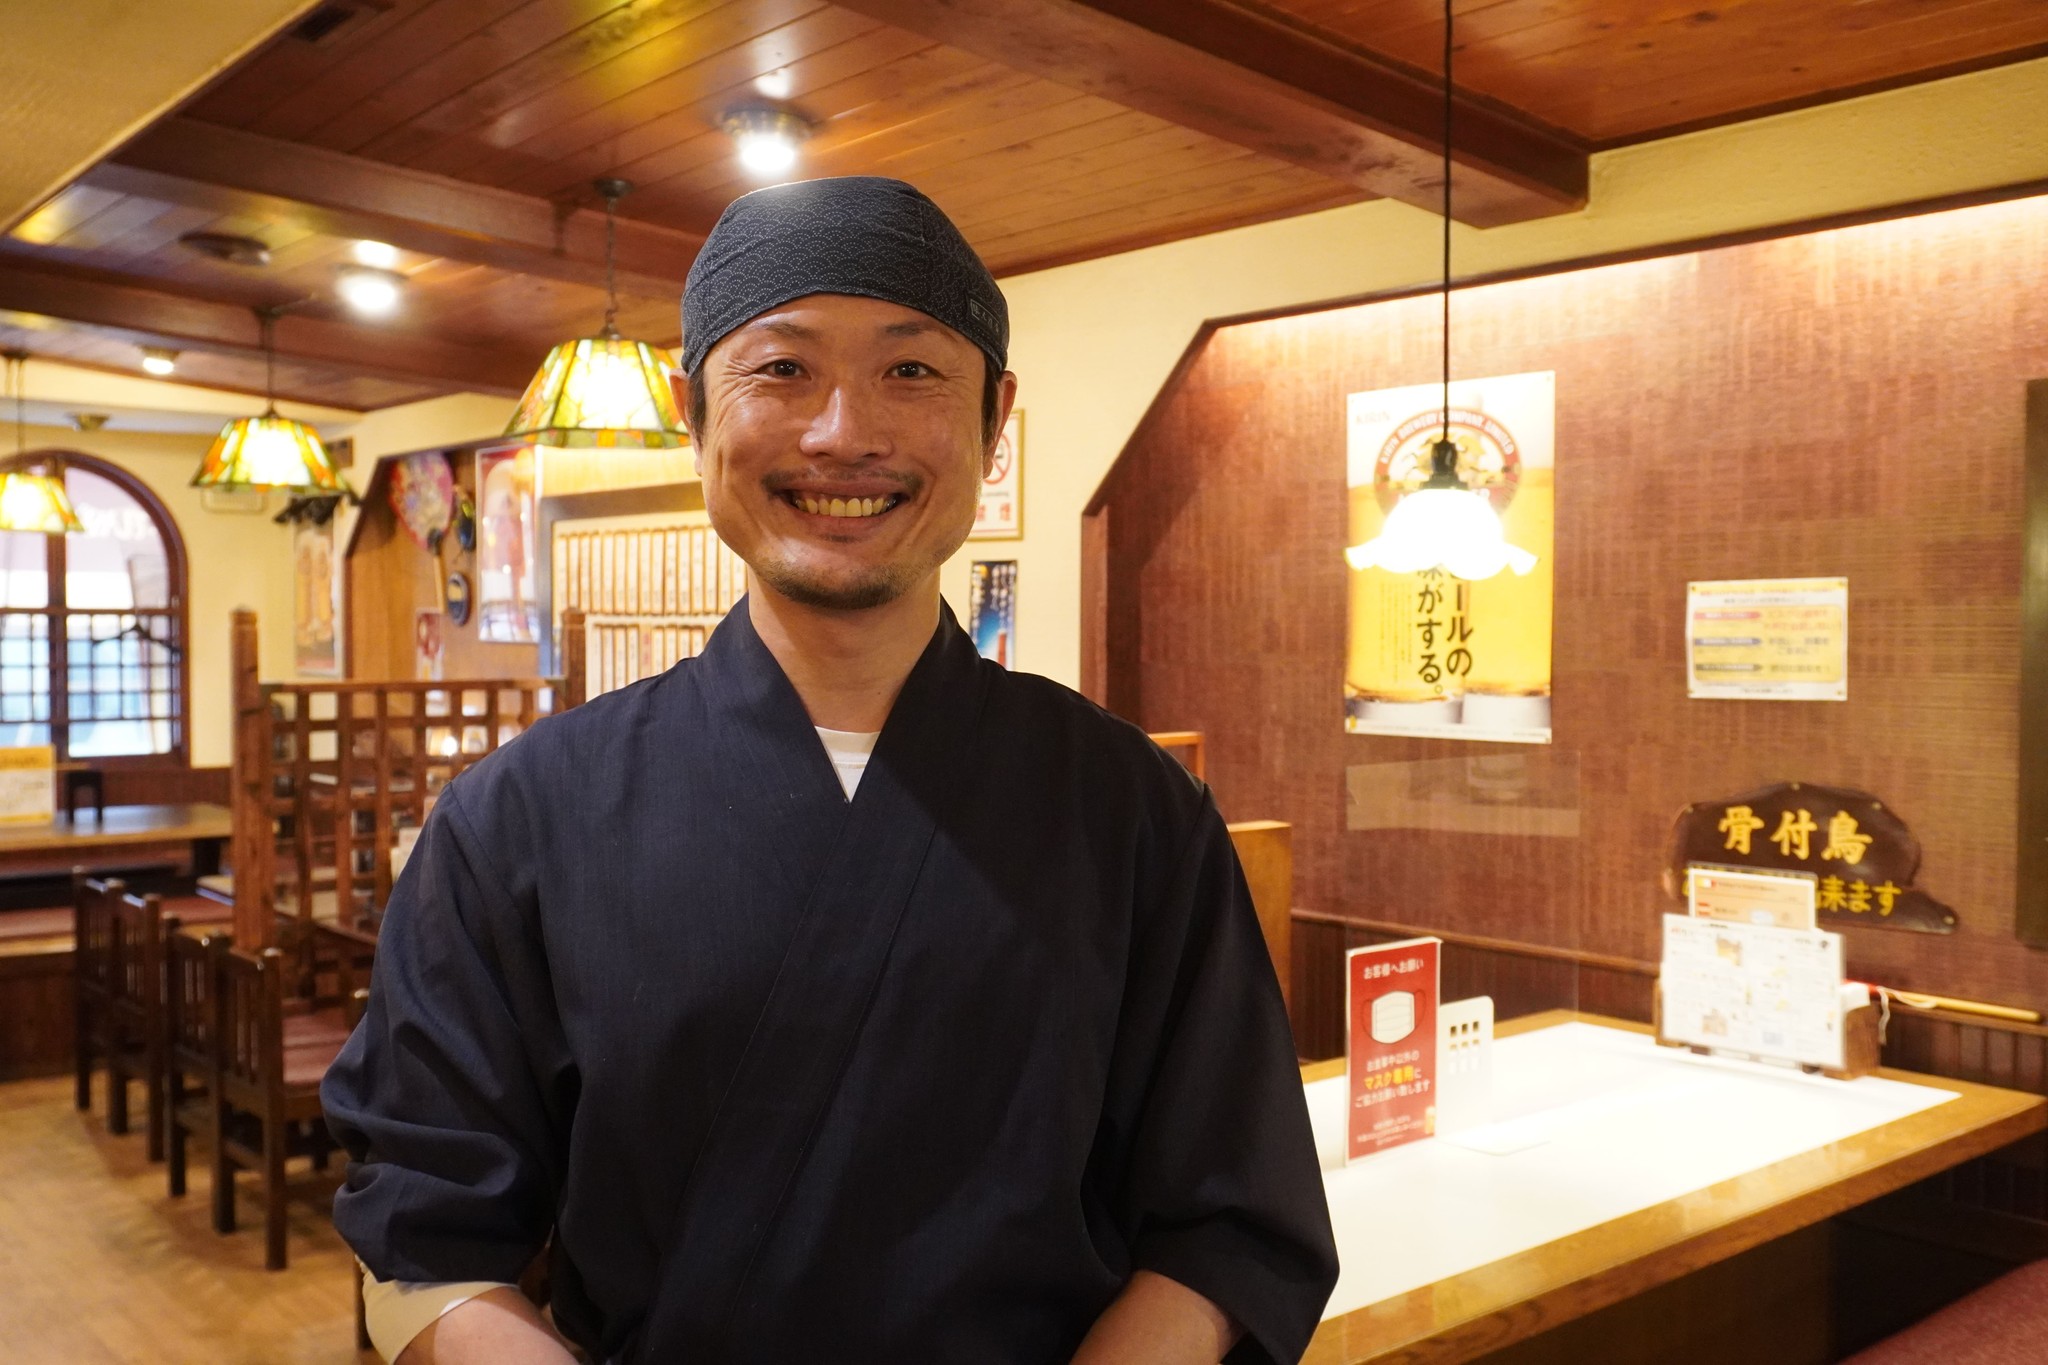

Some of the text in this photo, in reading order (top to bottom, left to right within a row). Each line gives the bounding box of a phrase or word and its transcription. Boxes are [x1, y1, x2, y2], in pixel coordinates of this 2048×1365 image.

[1446, 572, 1473, 677] ールの
[1718, 805, 1874, 865] 骨付鳥
